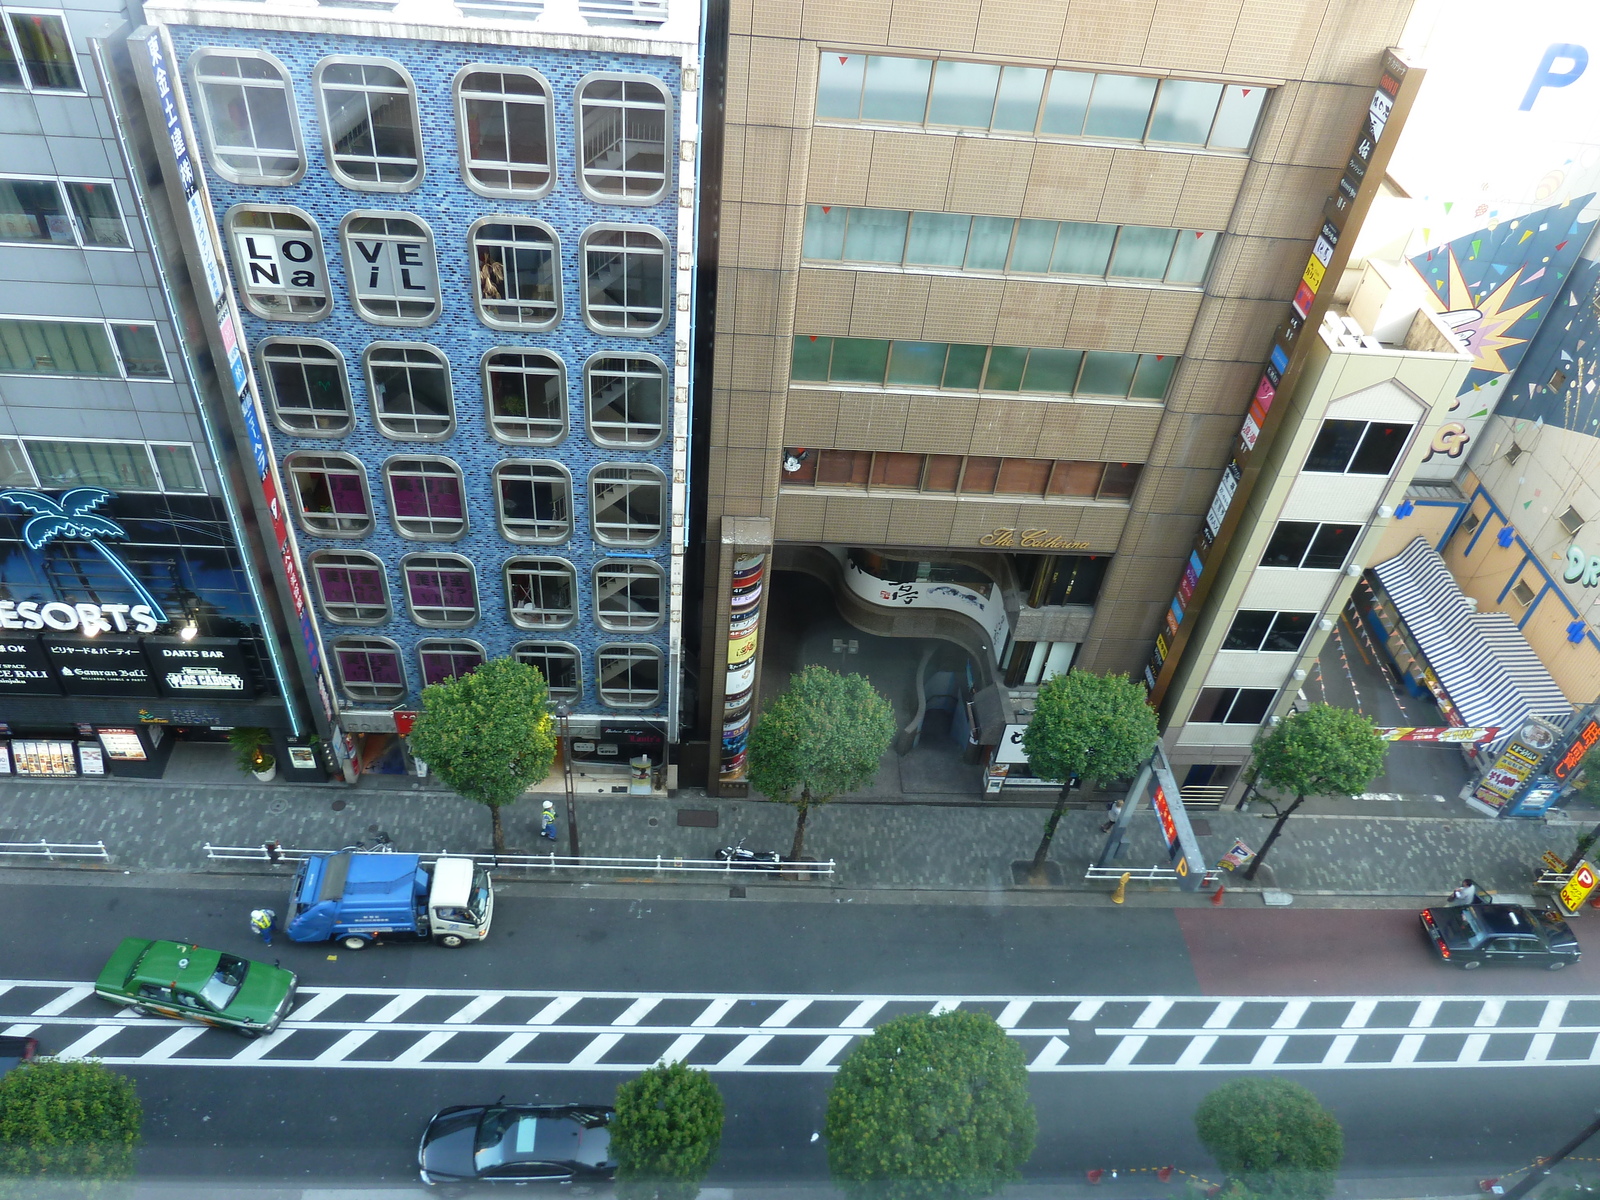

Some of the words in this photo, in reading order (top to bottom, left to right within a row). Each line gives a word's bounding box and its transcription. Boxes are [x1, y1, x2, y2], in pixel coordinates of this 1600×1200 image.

[1518, 43, 1588, 111] P
[980, 527, 1016, 547] The
[0, 600, 157, 632] ESORTS
[162, 649, 200, 658] DARTS
[201, 650, 224, 658] BAR
[15, 670, 49, 679] BALI
[180, 675, 197, 685] LOS
[1176, 856, 1188, 877] P
[1578, 869, 1593, 884] P
